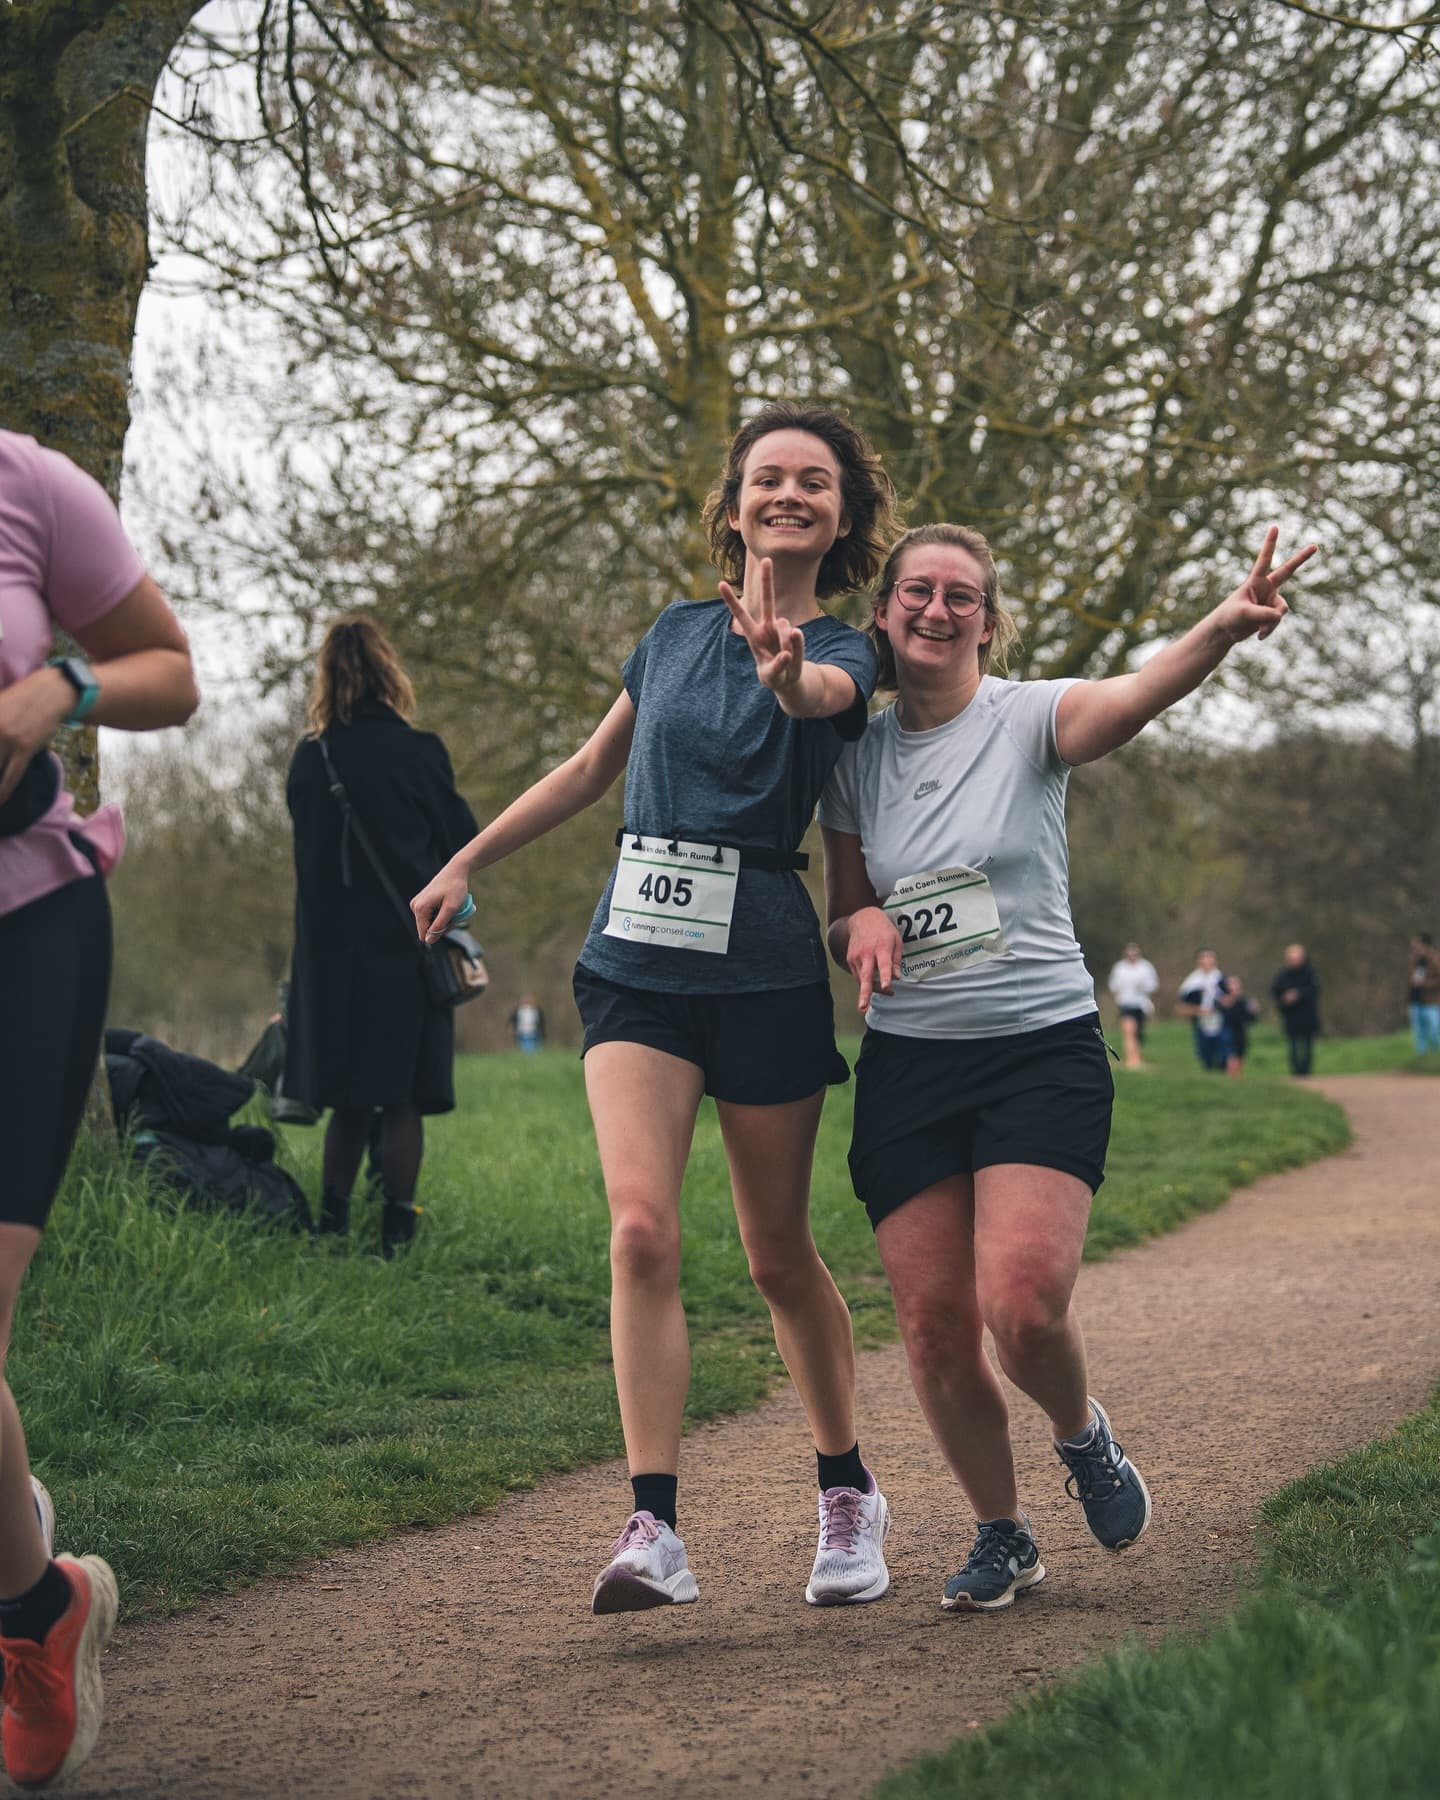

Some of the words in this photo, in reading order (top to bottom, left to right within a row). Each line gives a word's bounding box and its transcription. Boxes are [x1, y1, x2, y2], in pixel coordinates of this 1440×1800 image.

[654, 847, 666, 855] des
[638, 872, 694, 907] 405
[899, 886, 914, 895] des
[915, 879, 936, 890] Caen
[937, 871, 971, 884] Runners
[897, 902, 958, 944] 222
